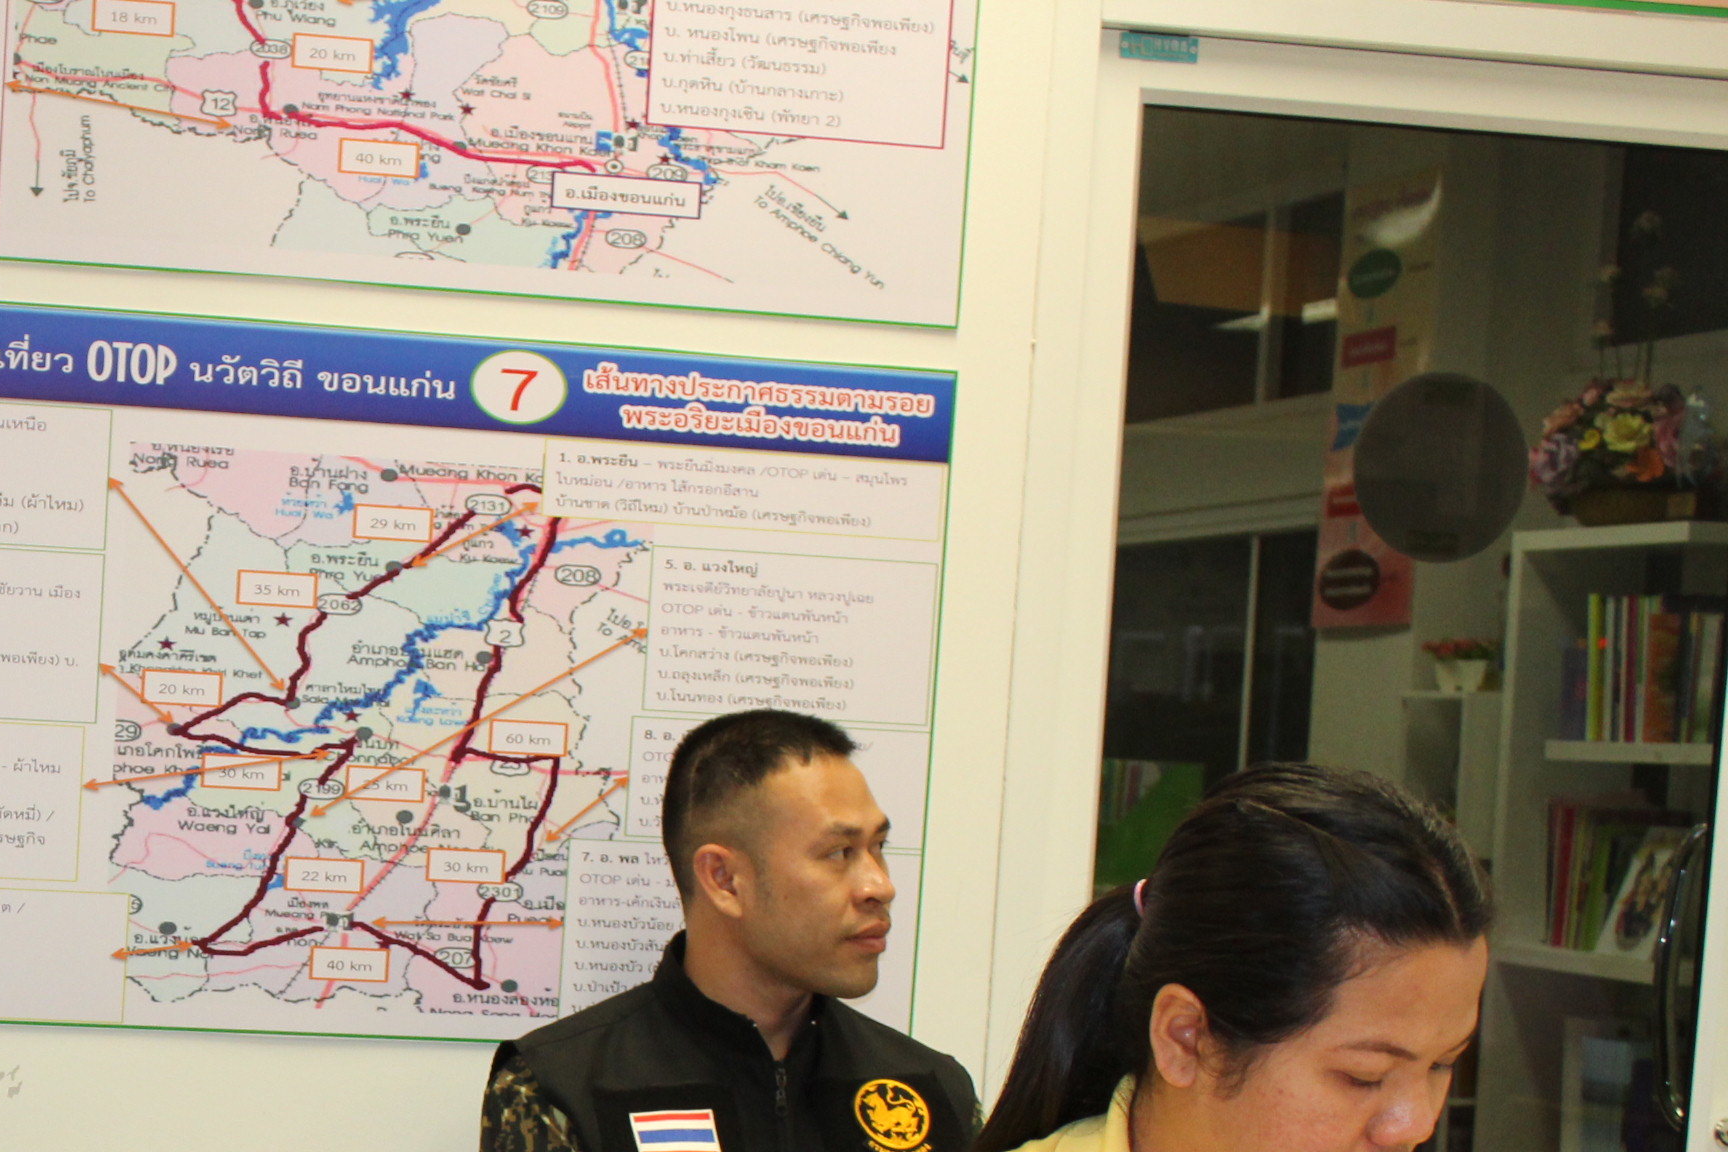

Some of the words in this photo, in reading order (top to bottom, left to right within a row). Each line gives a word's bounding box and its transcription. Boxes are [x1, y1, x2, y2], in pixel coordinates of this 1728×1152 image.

[112, 11, 128, 23] 18
[134, 12, 157, 24] km
[798, 11, 934, 34] (เศรษฐกิจพอเพียง)
[664, 26, 680, 37] บ.
[687, 26, 759, 44] หนองโพน
[766, 33, 896, 56] (เศรษฐกิจพอเพียง
[309, 48, 328, 60] 20
[333, 49, 356, 61] km
[741, 55, 826, 75] (วัฒนธรรม)
[661, 77, 723, 97] บ.กุดหิน
[728, 79, 844, 102] (บ้านกลางเกาะ)
[212, 98, 230, 110] 12
[771, 109, 819, 125] (พัทยา
[825, 115, 841, 128] 2)
[355, 153, 374, 164] 40
[379, 154, 402, 166] km
[566, 185, 685, 207] อ.เมืองขอนแก่น
[612, 230, 644, 246] 208
[87, 340, 177, 385] OTOP
[189, 355, 303, 389] นวัตวิถี
[317, 370, 455, 400] ขอนแก่น
[500, 368, 539, 411] 7
[584, 364, 932, 415] เส้นทางประกาศธรรมตามรอย
[622, 405, 899, 445] พระอริยะเมืองขอนแก่น
[370, 518, 388, 529] 29
[393, 520, 416, 531] km
[665, 559, 677, 570] 5.
[254, 584, 272, 595] 35
[277, 585, 300, 597] km
[301, 871, 319, 882] 22
[325, 872, 347, 882] km
